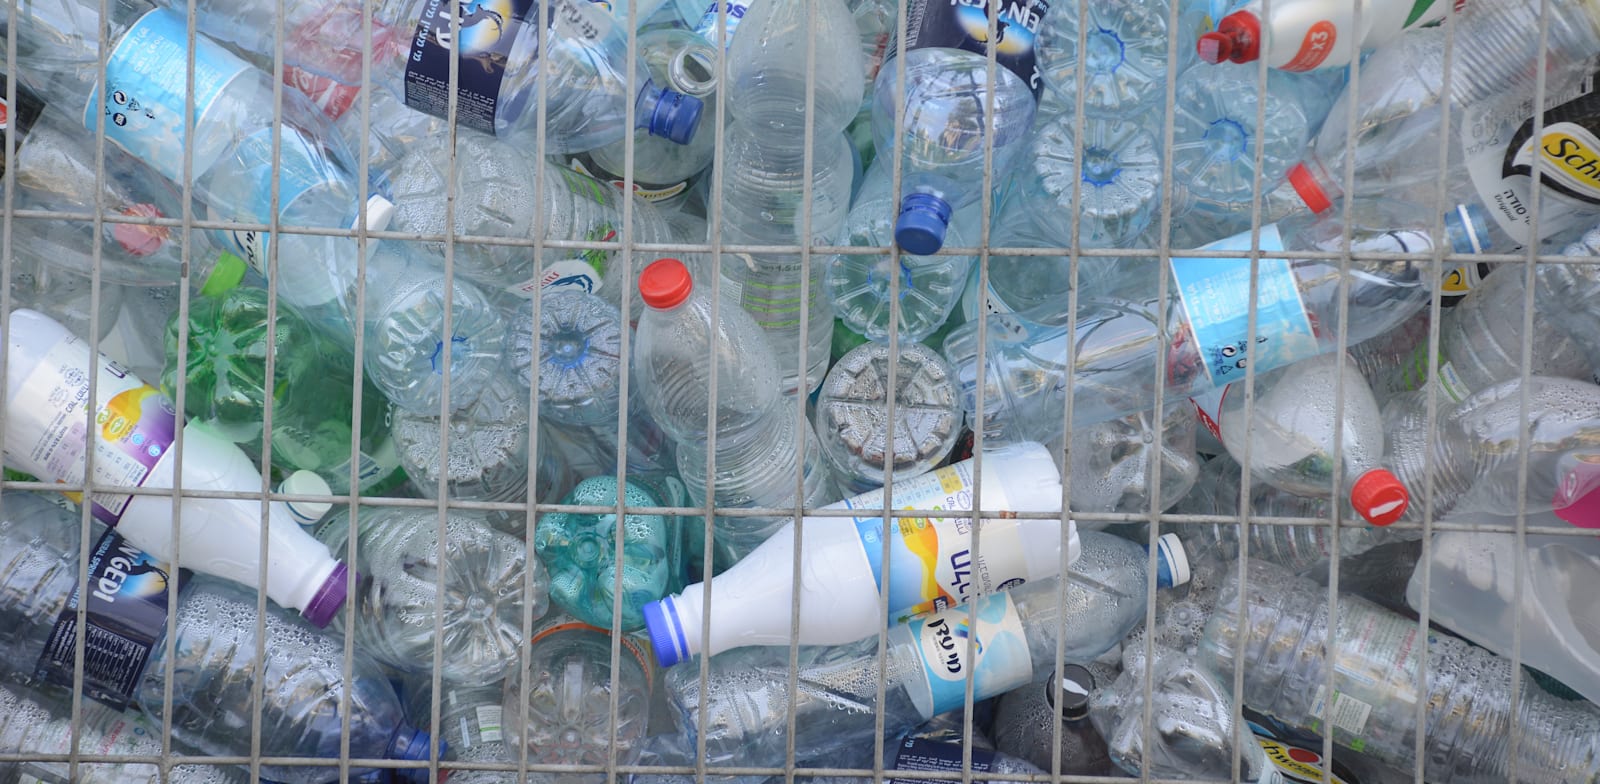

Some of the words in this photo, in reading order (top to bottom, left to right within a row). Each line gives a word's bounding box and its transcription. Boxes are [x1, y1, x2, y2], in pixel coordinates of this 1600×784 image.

[1008, 2, 1040, 34] EIN
[1494, 194, 1519, 221] Original
[1503, 189, 1527, 215] סודה
[92, 556, 132, 603] GEDI
[927, 618, 955, 651] עדן
[946, 652, 962, 674] מי
